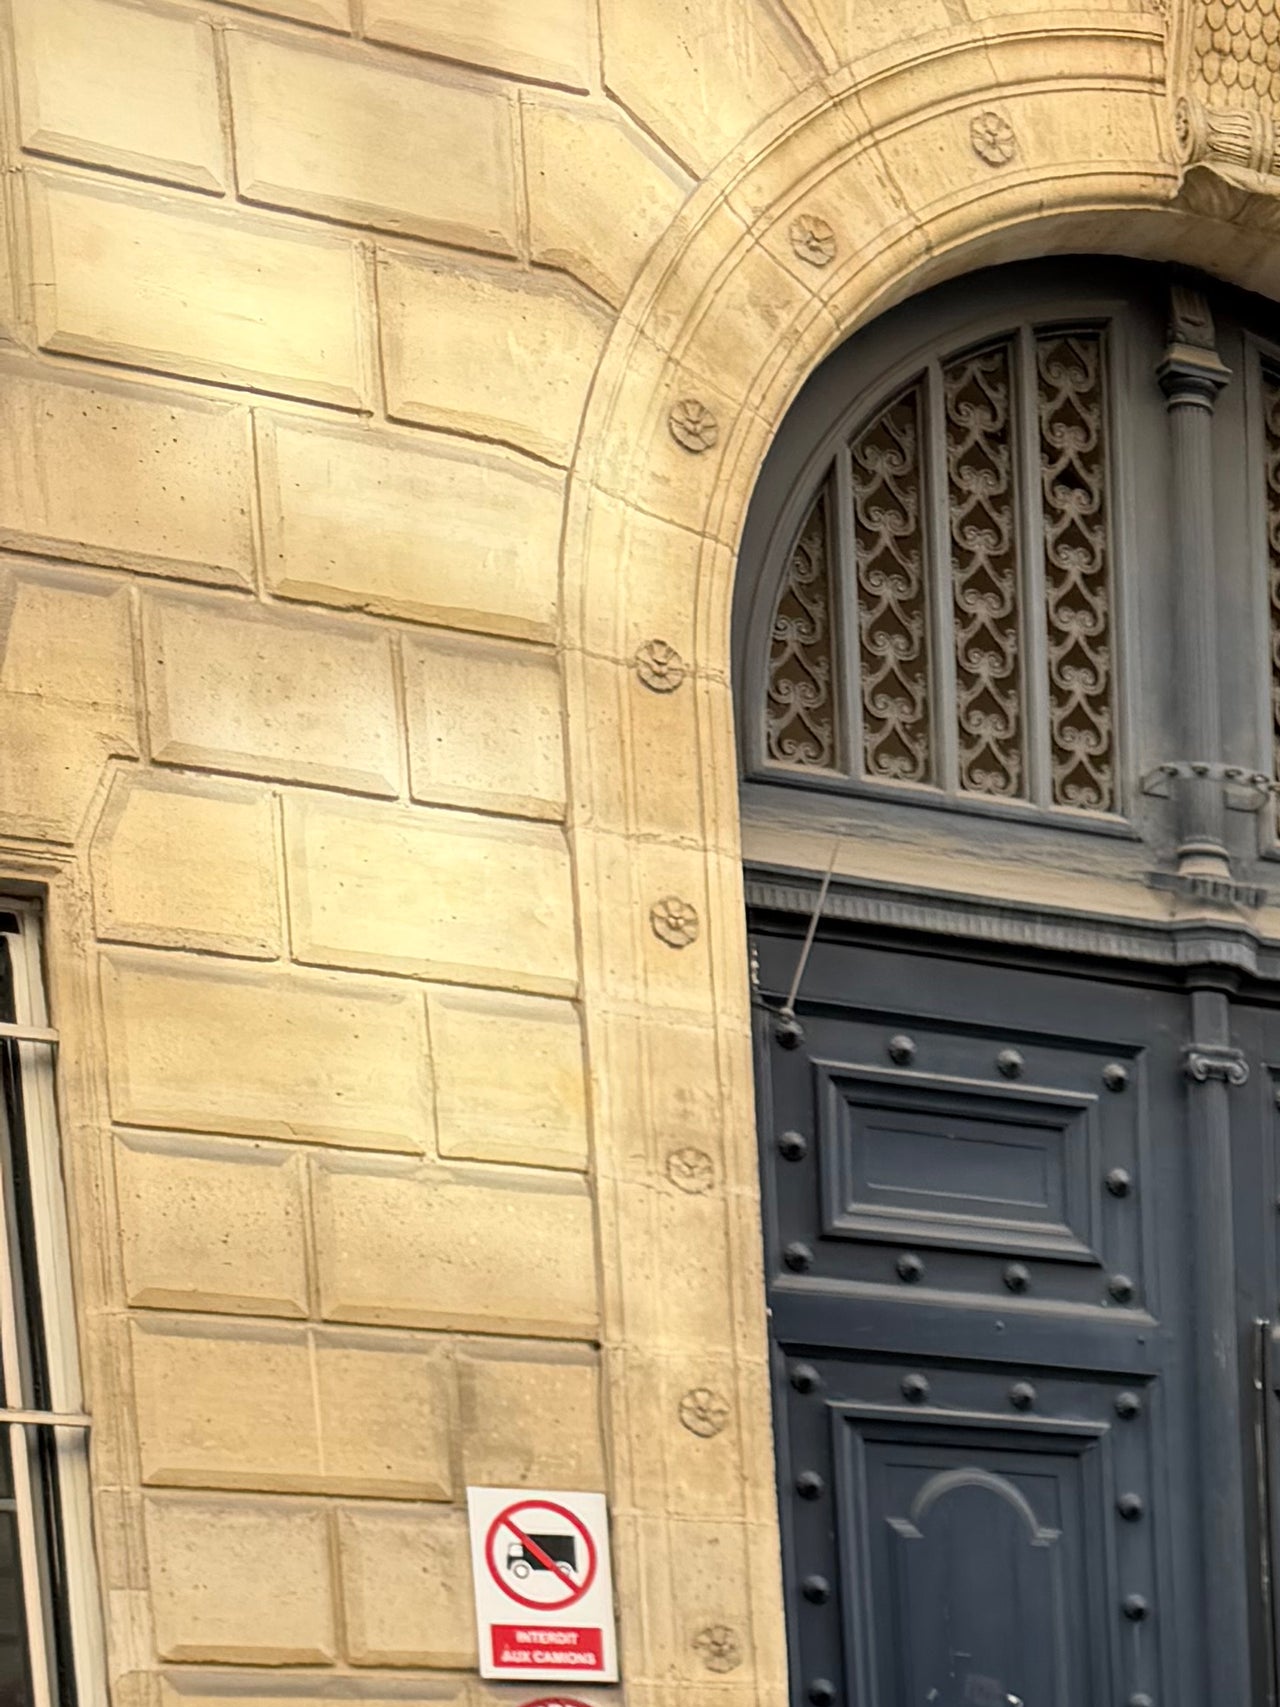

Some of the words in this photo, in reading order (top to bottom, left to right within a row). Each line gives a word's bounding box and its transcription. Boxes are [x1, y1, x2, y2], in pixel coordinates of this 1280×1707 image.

[515, 1630, 579, 1645] INTERDIT
[501, 1649, 532, 1663] AUX
[533, 1650, 597, 1665] CAMIONS
